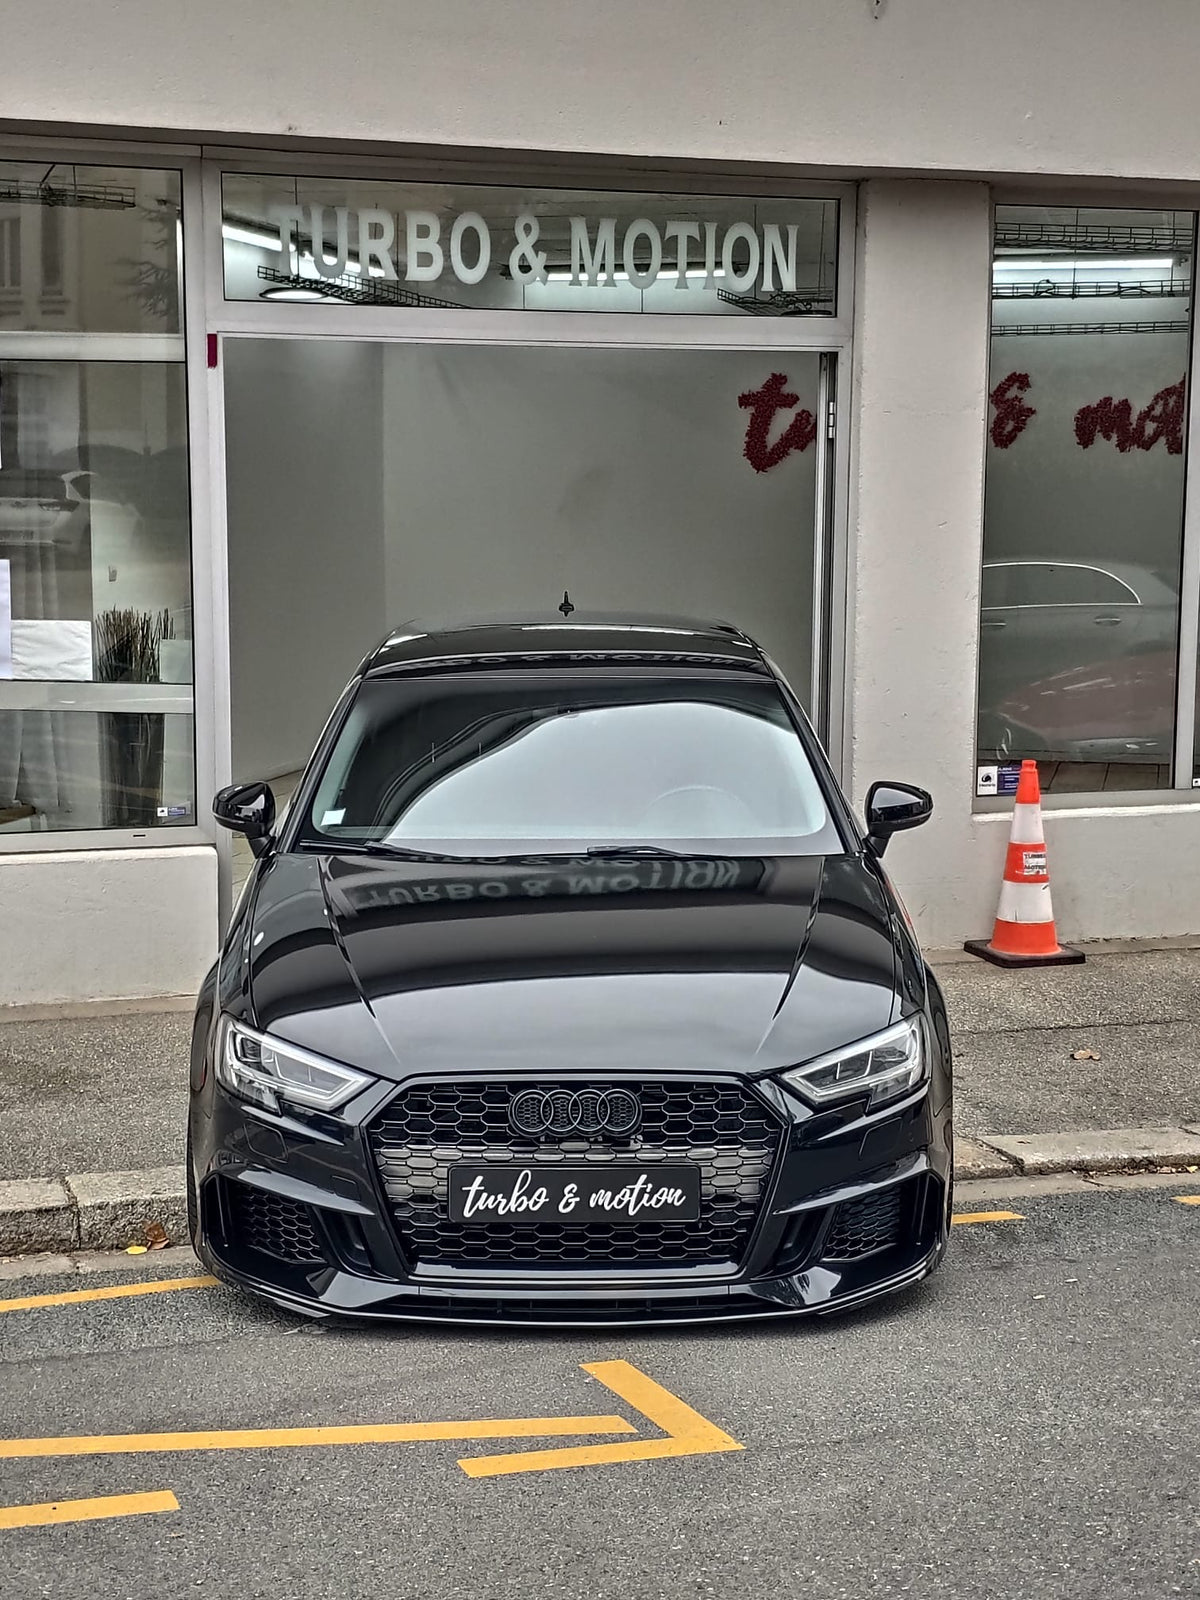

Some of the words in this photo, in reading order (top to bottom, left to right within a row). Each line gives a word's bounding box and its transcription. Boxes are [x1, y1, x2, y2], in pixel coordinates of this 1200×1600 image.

[270, 203, 492, 286] TURBO
[508, 214, 549, 286] &
[570, 216, 800, 294] MOTION
[462, 1169, 549, 1218] turbo
[558, 1183, 581, 1214] &
[589, 1174, 686, 1216] motion
